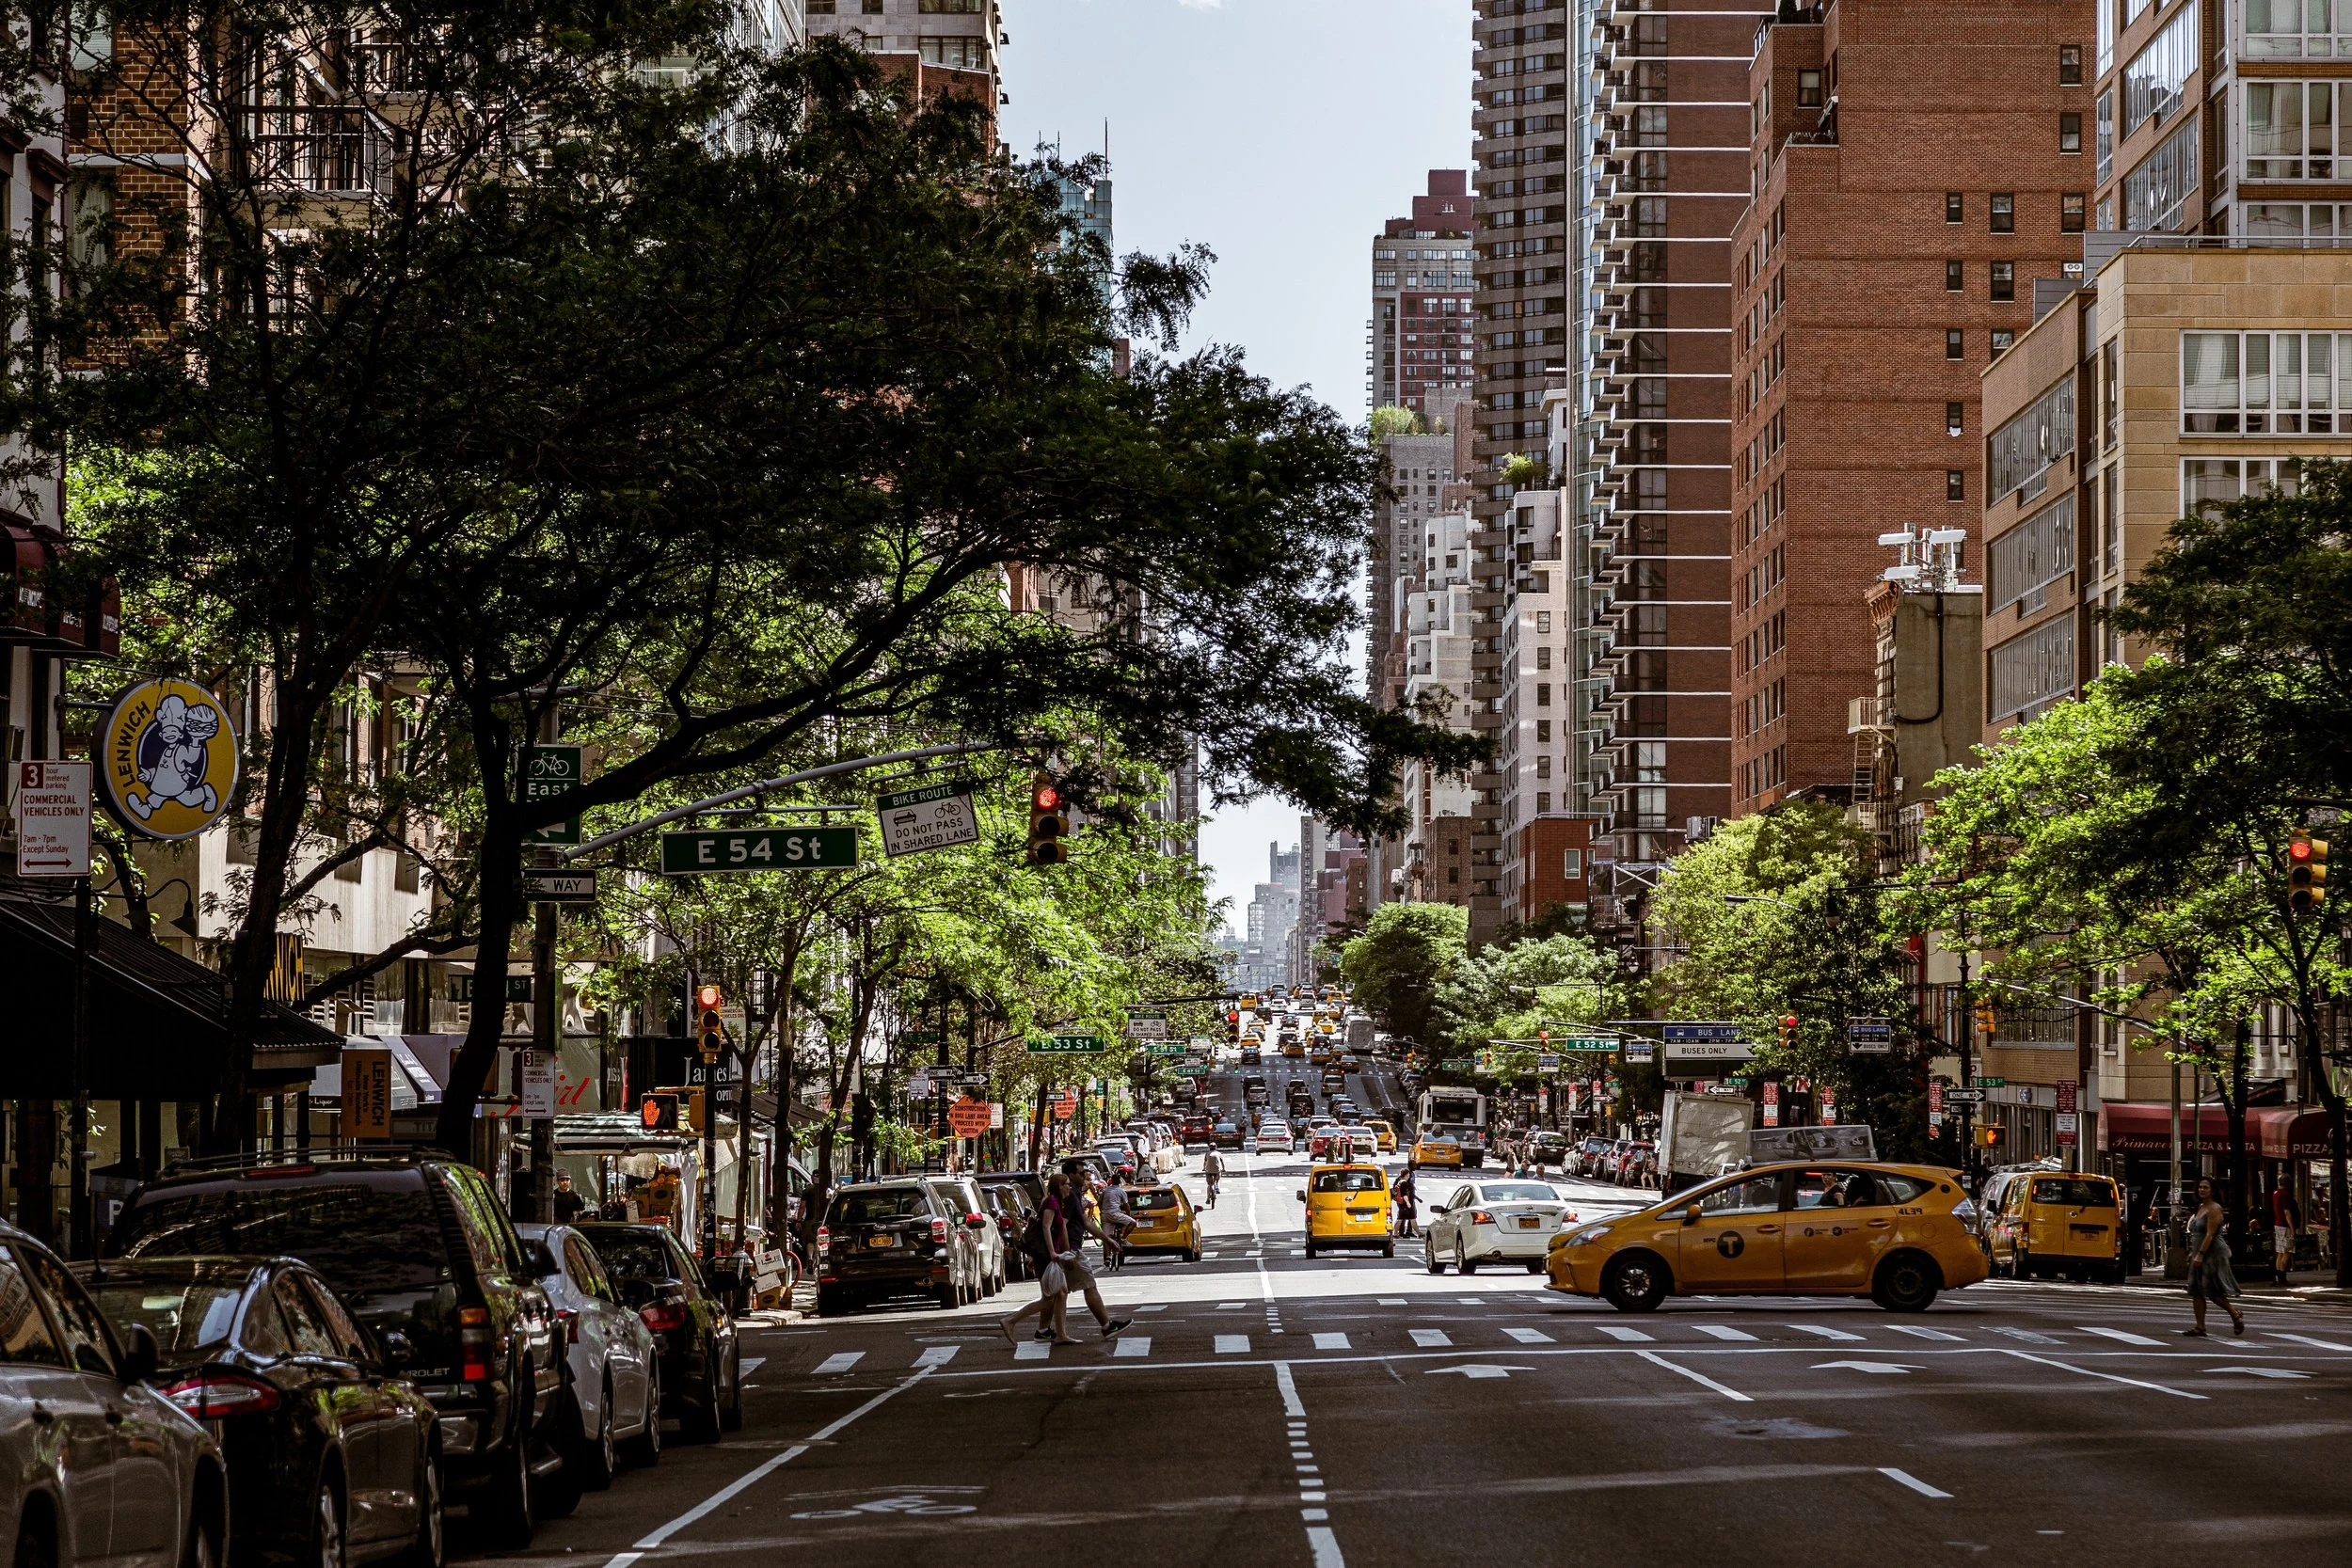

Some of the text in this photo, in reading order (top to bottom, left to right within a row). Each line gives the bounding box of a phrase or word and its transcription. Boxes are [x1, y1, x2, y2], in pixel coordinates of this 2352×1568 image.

[116, 700, 151, 788] LENWICH
[26, 765, 39, 787] 3
[528, 782, 570, 796] East
[893, 784, 955, 807] BIKE ROUTE
[24, 795, 77, 805] COMMERCIAL
[24, 807, 85, 816] VEHICLES ONLY
[895, 817, 963, 839] DO NOT PASS
[24, 834, 38, 843] 7am
[42, 834, 57, 844] 7pm
[890, 827, 974, 853] IN SHARED LANE
[23, 845, 69, 855] Except Sunday
[697, 836, 823, 863] E 54 St
[553, 879, 583, 893] WAY
[514, 980, 528, 990] ST
[1041, 1038, 1090, 1050] E 53 St
[1576, 1040, 1611, 1049] E 52 St
[526, 1053, 532, 1066] 3
[1979, 1078, 1983, 1086] E
[1986, 1078, 1996, 1086] 53
[372, 1060, 385, 1126] LENWICH
[314, 1097, 333, 1107] Liquor
[2112, 1135, 2172, 1149] Primave
[2186, 1140, 2215, 1150] PIZZA
[2217, 1141, 2224, 1150] &
[2226, 1141, 2256, 1151] PTA
[2292, 1143, 2328, 1154] PIZZA
